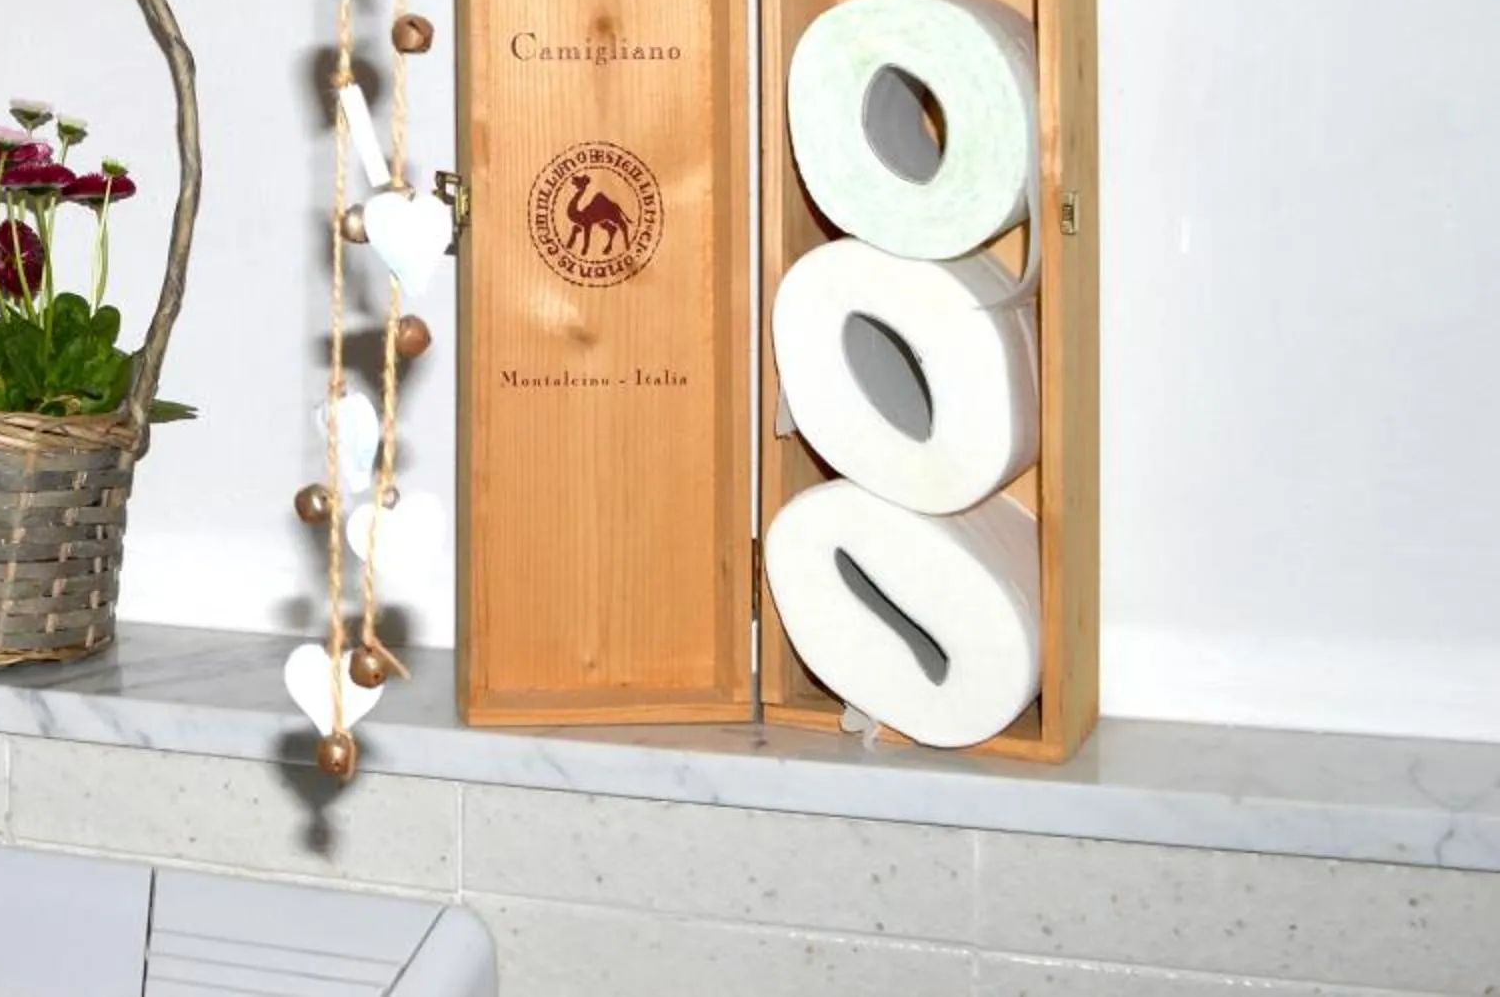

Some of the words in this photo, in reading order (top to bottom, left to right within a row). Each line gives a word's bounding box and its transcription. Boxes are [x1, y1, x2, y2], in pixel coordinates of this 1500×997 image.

[510, 31, 682, 66] Camigliano
[500, 370, 610, 388] Montalcino
[634, 368, 688, 386] Italia
